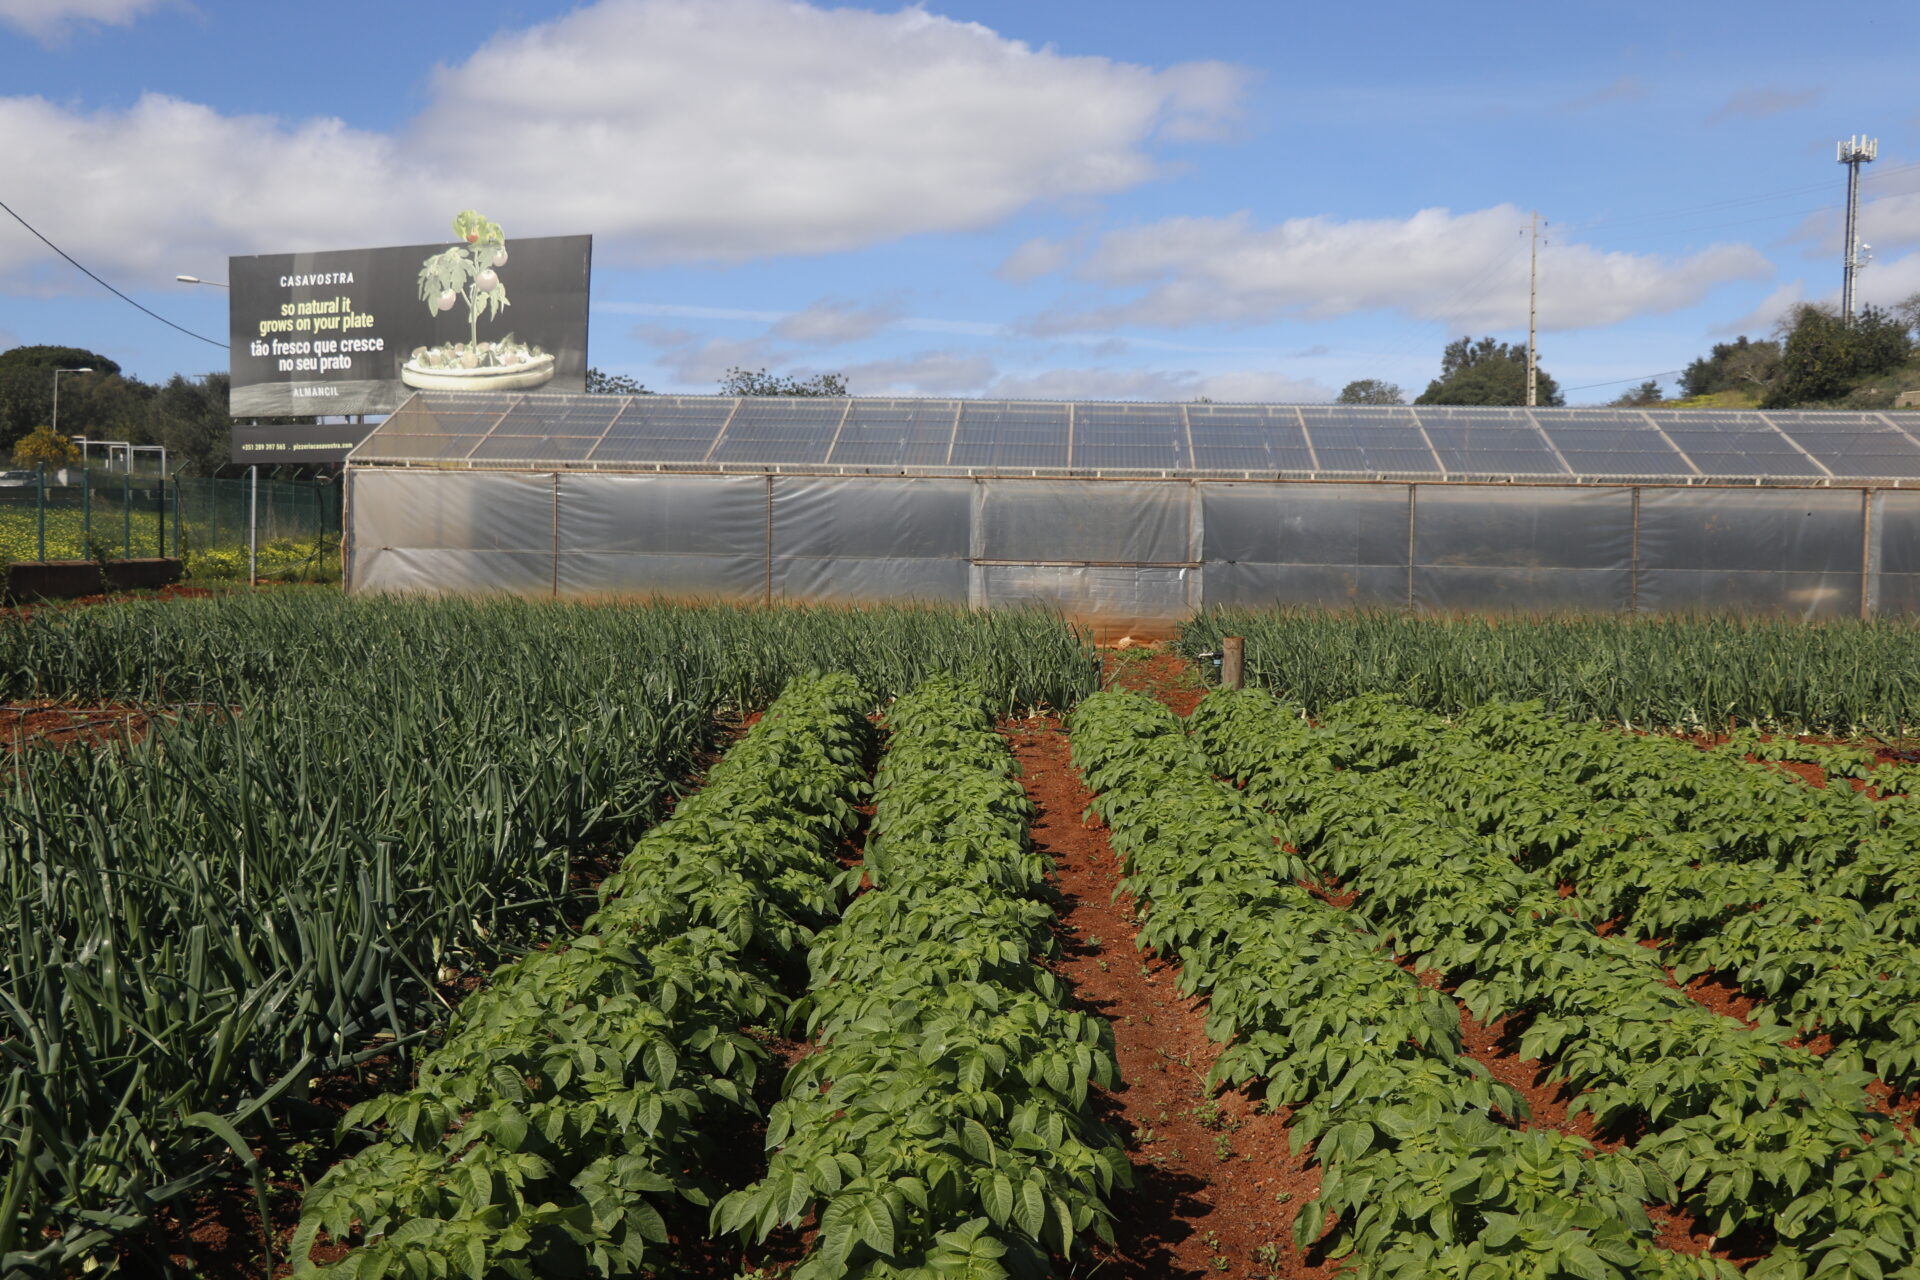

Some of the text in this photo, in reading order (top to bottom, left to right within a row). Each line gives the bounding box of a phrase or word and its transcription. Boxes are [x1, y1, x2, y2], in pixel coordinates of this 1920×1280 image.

[280, 272, 354, 288] CASAVOSTRA
[281, 297, 351, 316] so natural it
[260, 312, 374, 337] grows on your plate
[251, 338, 384, 357] tão fresco que cresce
[279, 355, 352, 374] no seu prato
[293, 386, 339, 397] ALMANCIL
